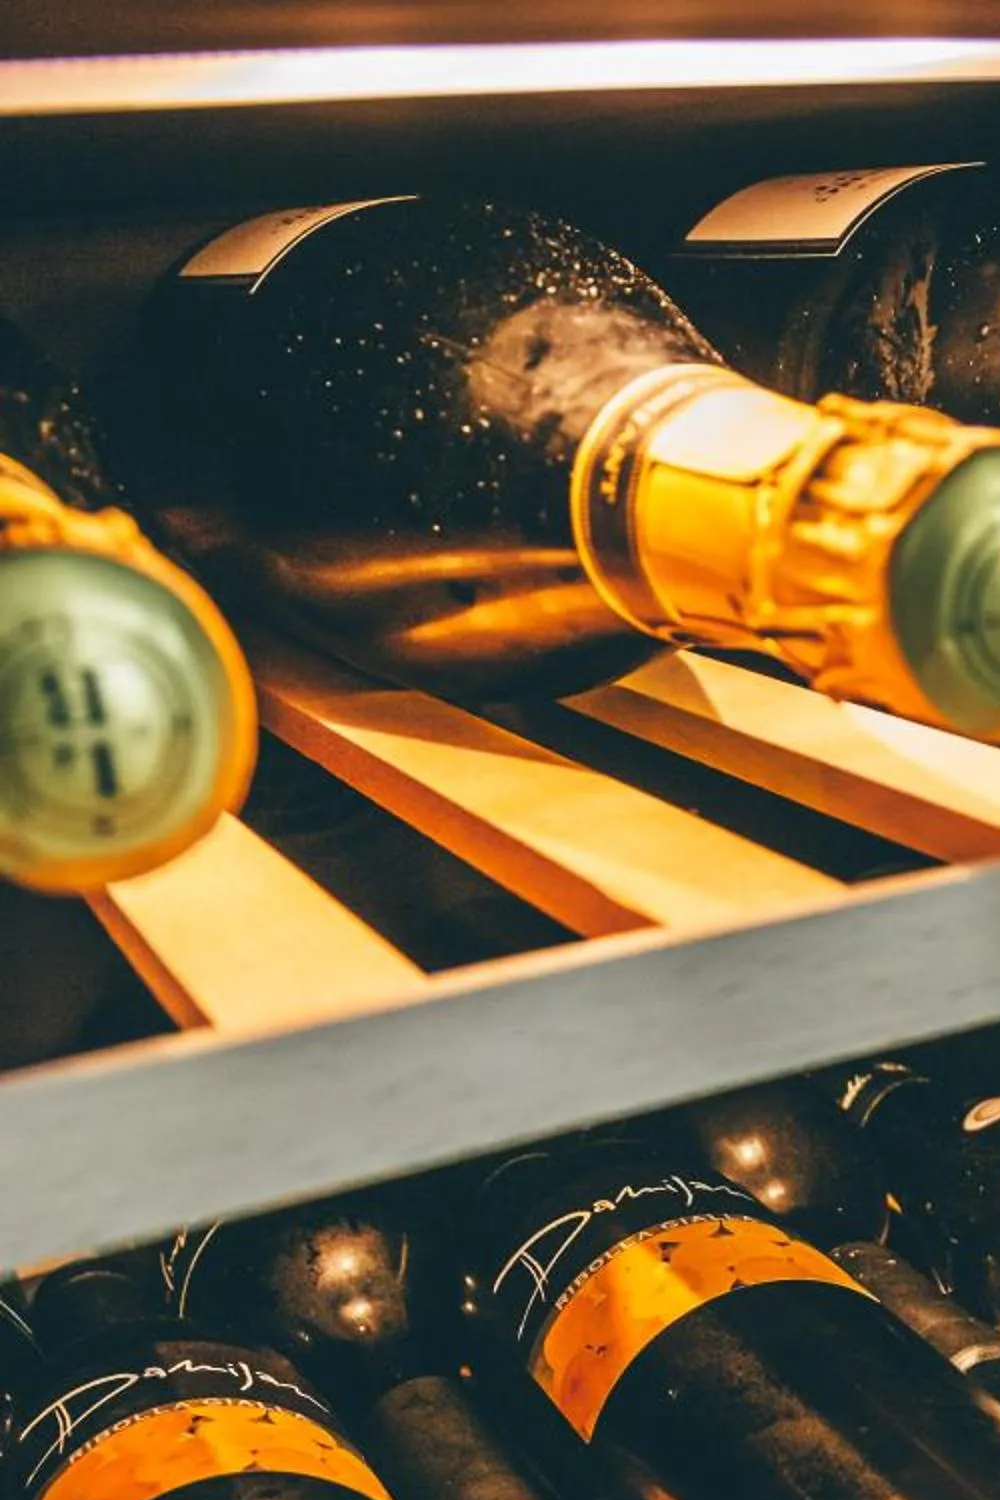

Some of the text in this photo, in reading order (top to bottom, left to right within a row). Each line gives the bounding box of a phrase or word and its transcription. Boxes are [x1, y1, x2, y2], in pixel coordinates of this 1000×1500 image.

[554, 1230, 654, 1311] RIBOLLA
[17, 1358, 333, 1487] Damijan
[68, 1399, 191, 1464] RIBOLLA
